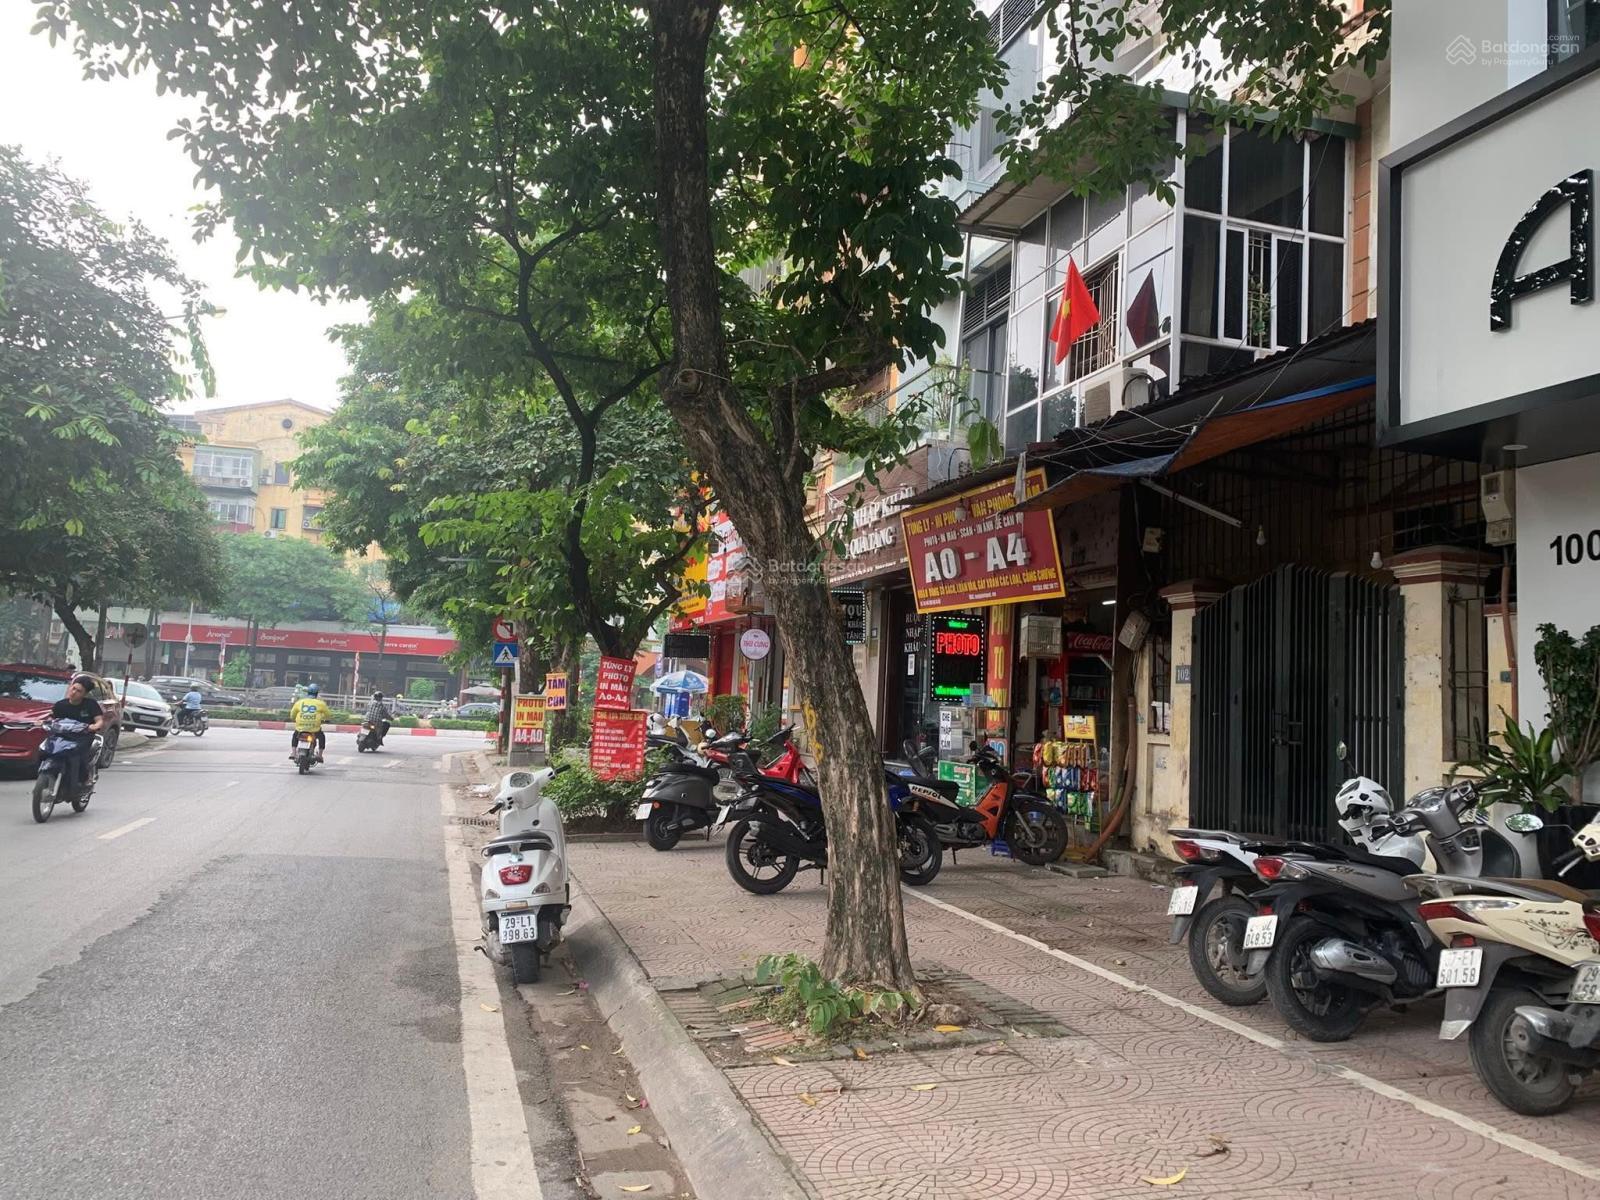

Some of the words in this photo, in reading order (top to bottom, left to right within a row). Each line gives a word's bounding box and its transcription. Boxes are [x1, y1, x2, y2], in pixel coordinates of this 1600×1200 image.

[986, 532, 1027, 572] A4
[936, 632, 980, 656] PHOTO
[602, 671, 629, 682] PHOTO
[600, 682, 609, 690] IN
[302, 701, 317, 713] be
[517, 698, 544, 708] PHOTO
[514, 728, 543, 743] A4-A0
